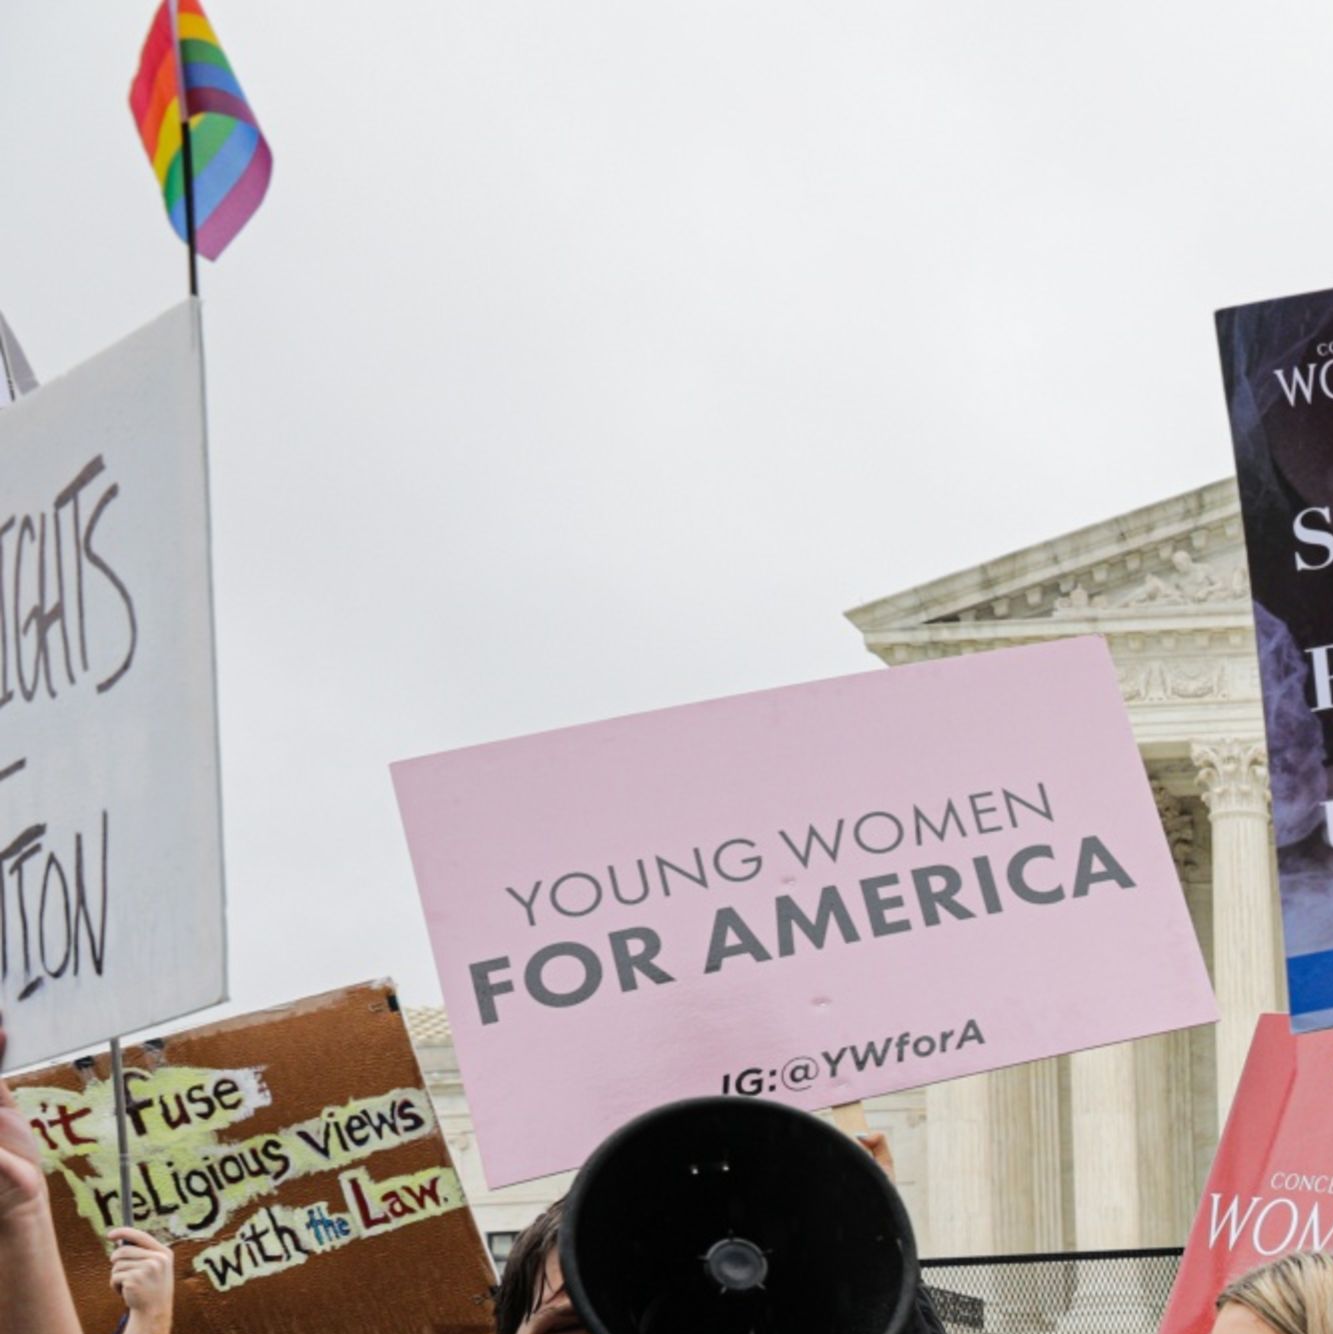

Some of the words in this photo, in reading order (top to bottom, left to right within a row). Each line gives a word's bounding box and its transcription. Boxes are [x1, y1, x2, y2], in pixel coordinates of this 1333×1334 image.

[506, 837, 764, 927] YOUNG
[777, 781, 1056, 869] WOMEN
[468, 924, 676, 1025] FOR
[702, 834, 1137, 975] AMERICA
[720, 1018, 986, 1098] IG:@YWforA
[122, 1071, 244, 1136] fuse
[296, 1095, 425, 1161] views
[203, 1205, 308, 1289] with
[304, 1205, 353, 1247] the
